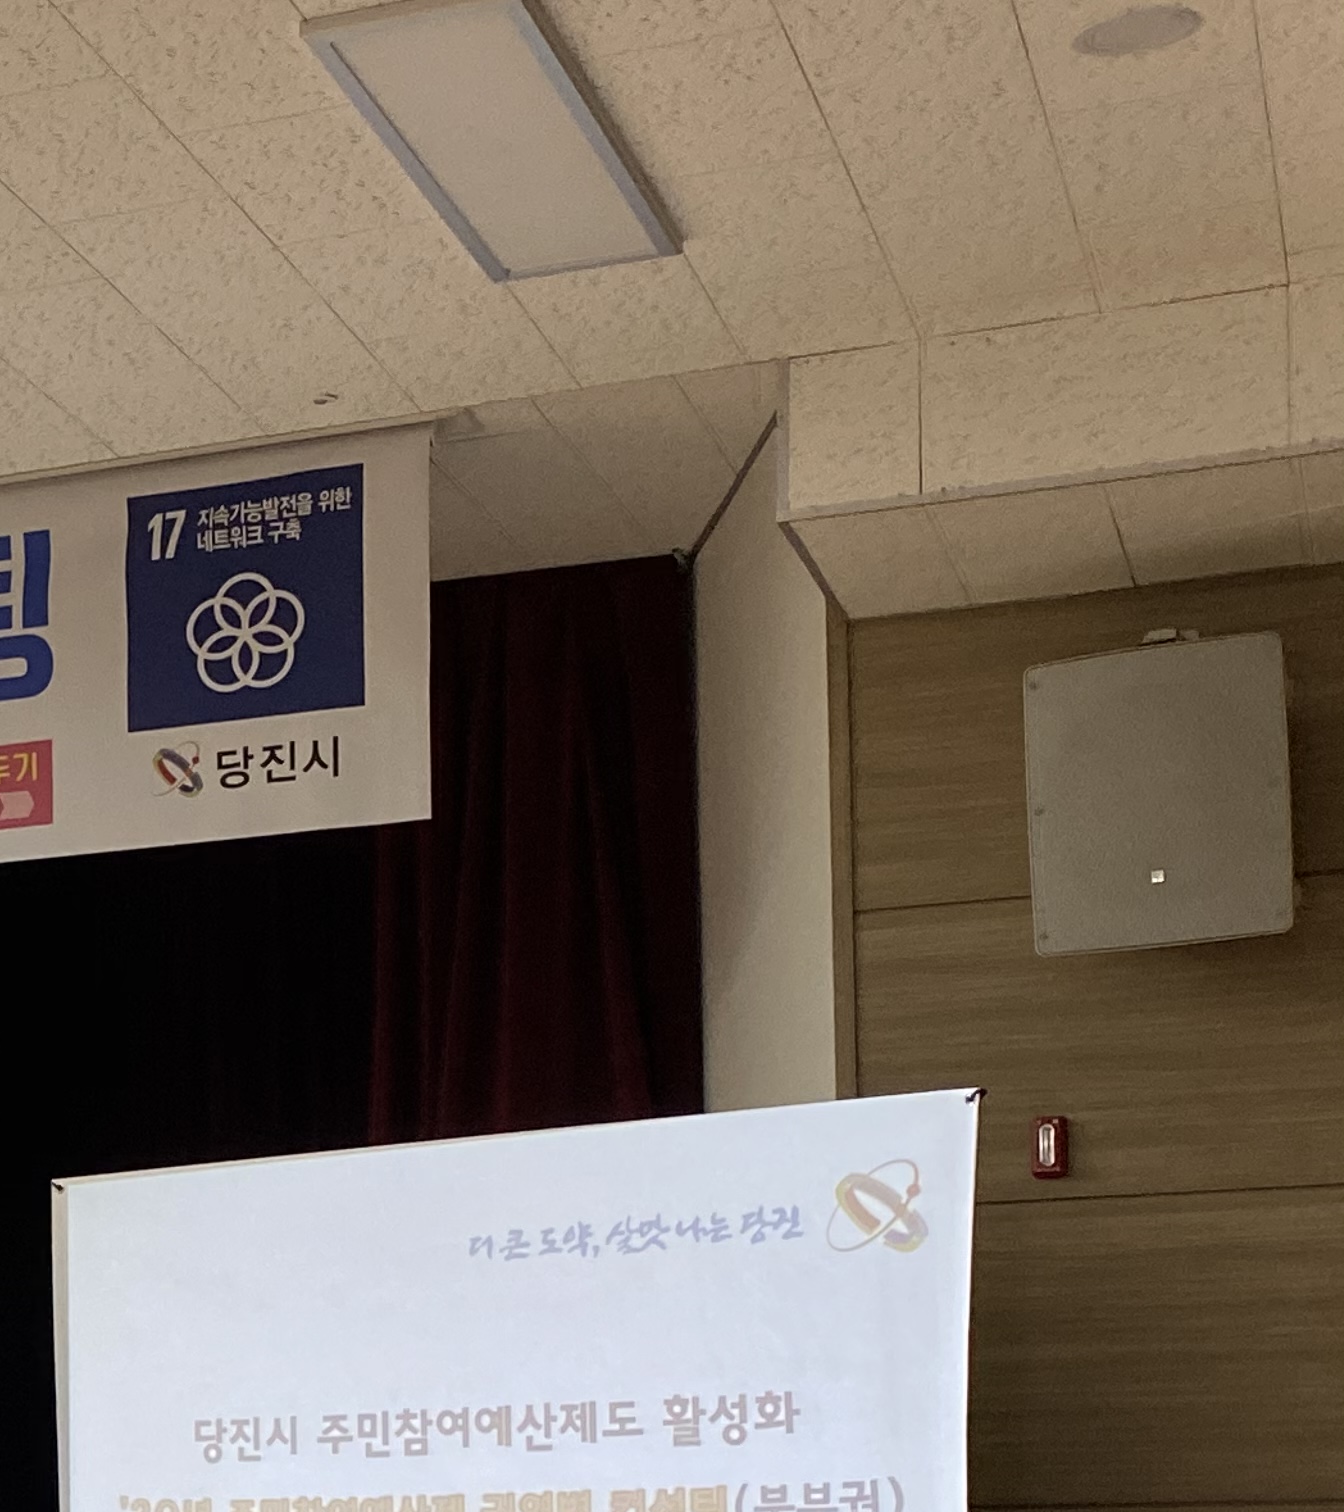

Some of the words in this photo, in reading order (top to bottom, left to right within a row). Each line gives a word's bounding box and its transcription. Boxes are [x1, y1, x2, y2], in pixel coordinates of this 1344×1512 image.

[197, 492, 312, 529] 지속가능발전을
[318, 486, 352, 513] 위한
[148, 509, 187, 561] 17
[197, 525, 264, 552] 네트워크
[267, 518, 302, 544] 구축
[215, 736, 341, 790] 당진시
[469, 1235, 494, 1260] 더
[499, 1229, 530, 1261] 큰
[739, 1204, 805, 1245] 당진
[193, 1415, 300, 1466] 당진시
[316, 1395, 645, 1461] 주민참여예산제도
[662, 1388, 800, 1448] 활성화
